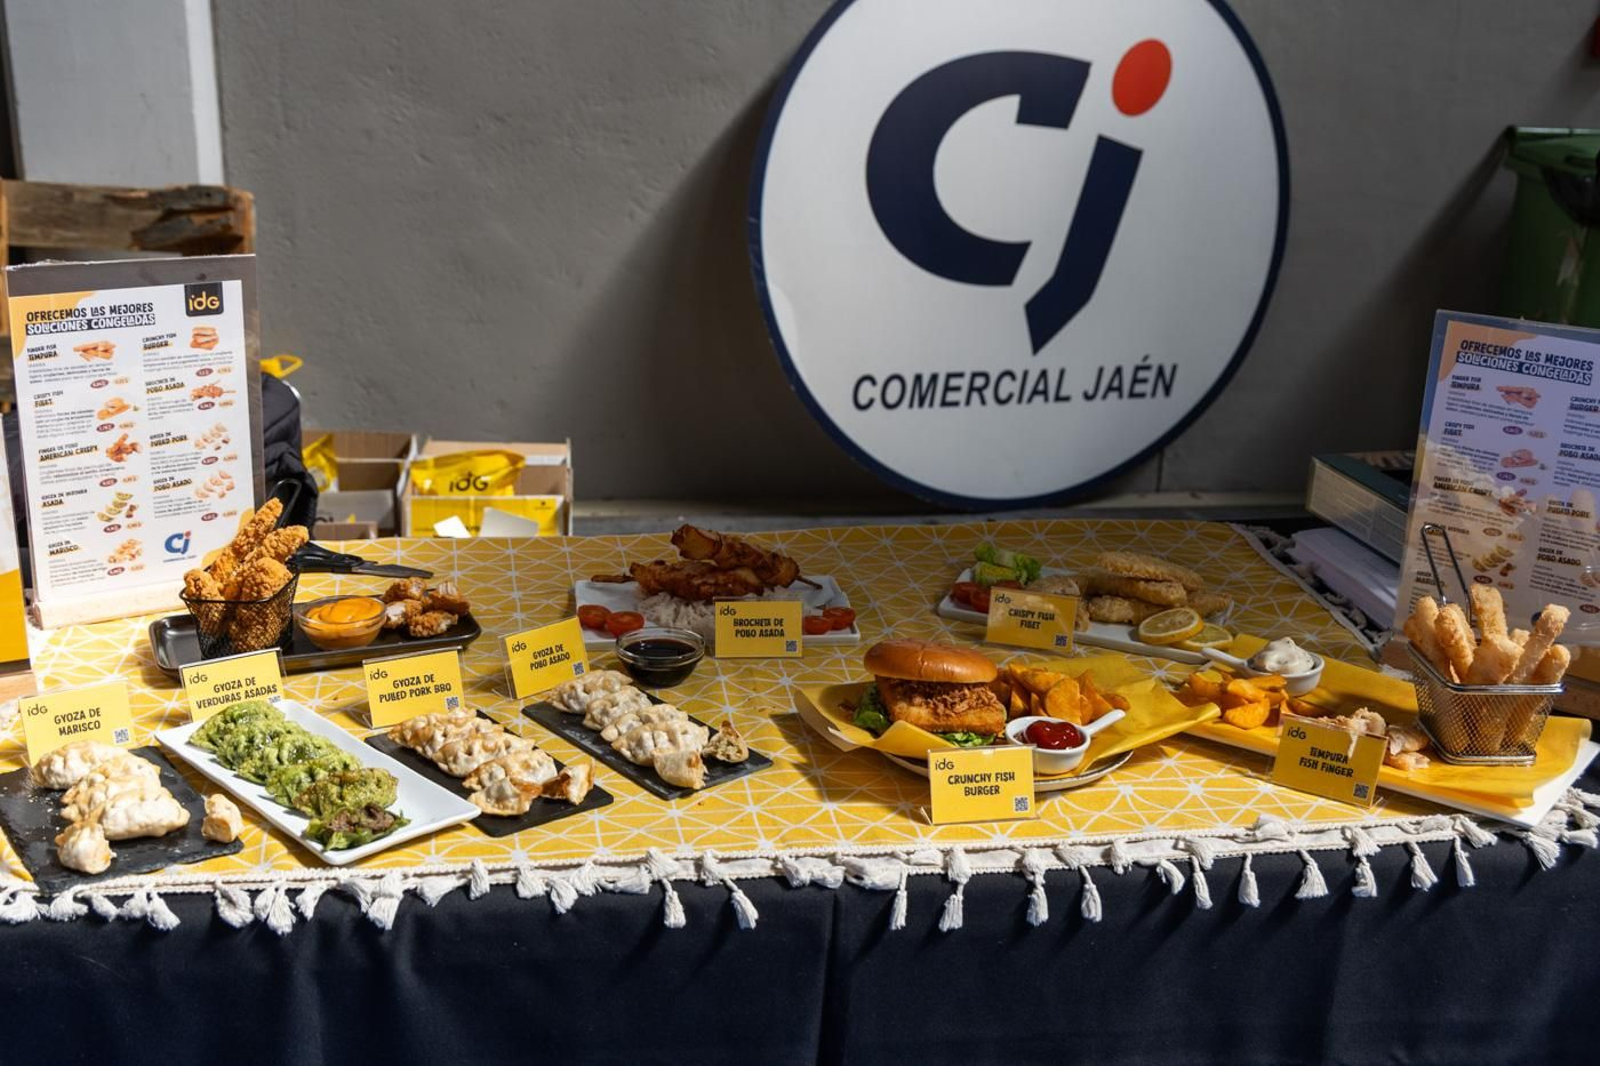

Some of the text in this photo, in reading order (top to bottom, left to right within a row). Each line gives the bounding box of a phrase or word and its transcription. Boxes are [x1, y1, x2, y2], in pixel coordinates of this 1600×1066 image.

[26, 302, 154, 322] OFRECEMOS LAS MEJORES
[28, 315, 155, 335] SOLUCIONES CONGELADAS
[1460, 340, 1594, 372] OFRECEMOS LAS MEJORES
[1458, 352, 1592, 385] SOLUCIONES CONGELADAS
[852, 354, 1178, 411] COMERCIAL JAÉN
[1570, 403, 1599, 412] BURGER
[40, 450, 74, 462] AMERICAN
[42, 499, 64, 508] ASADA
[49, 545, 79, 556] MARISCO
[1008, 608, 1055, 621] CRISPY FISH
[733, 618, 784, 627] BROCHETA DE
[759, 629, 784, 637] ASADA
[532, 644, 564, 659] GYOZA DE
[549, 652, 570, 665] ASADO
[213, 677, 256, 693] GYOZA DE
[393, 674, 434, 689] GYOZA DE
[196, 684, 278, 709] VERDURAS ASADAS
[379, 683, 451, 703] PULLED PORK BBQ
[54, 708, 101, 725] GYOZA DE
[59, 720, 101, 736] MARISCO
[1310, 747, 1348, 764] TEMPURA
[948, 772, 1015, 785] CRUNCHY FISH
[964, 785, 1000, 796] BURGER
